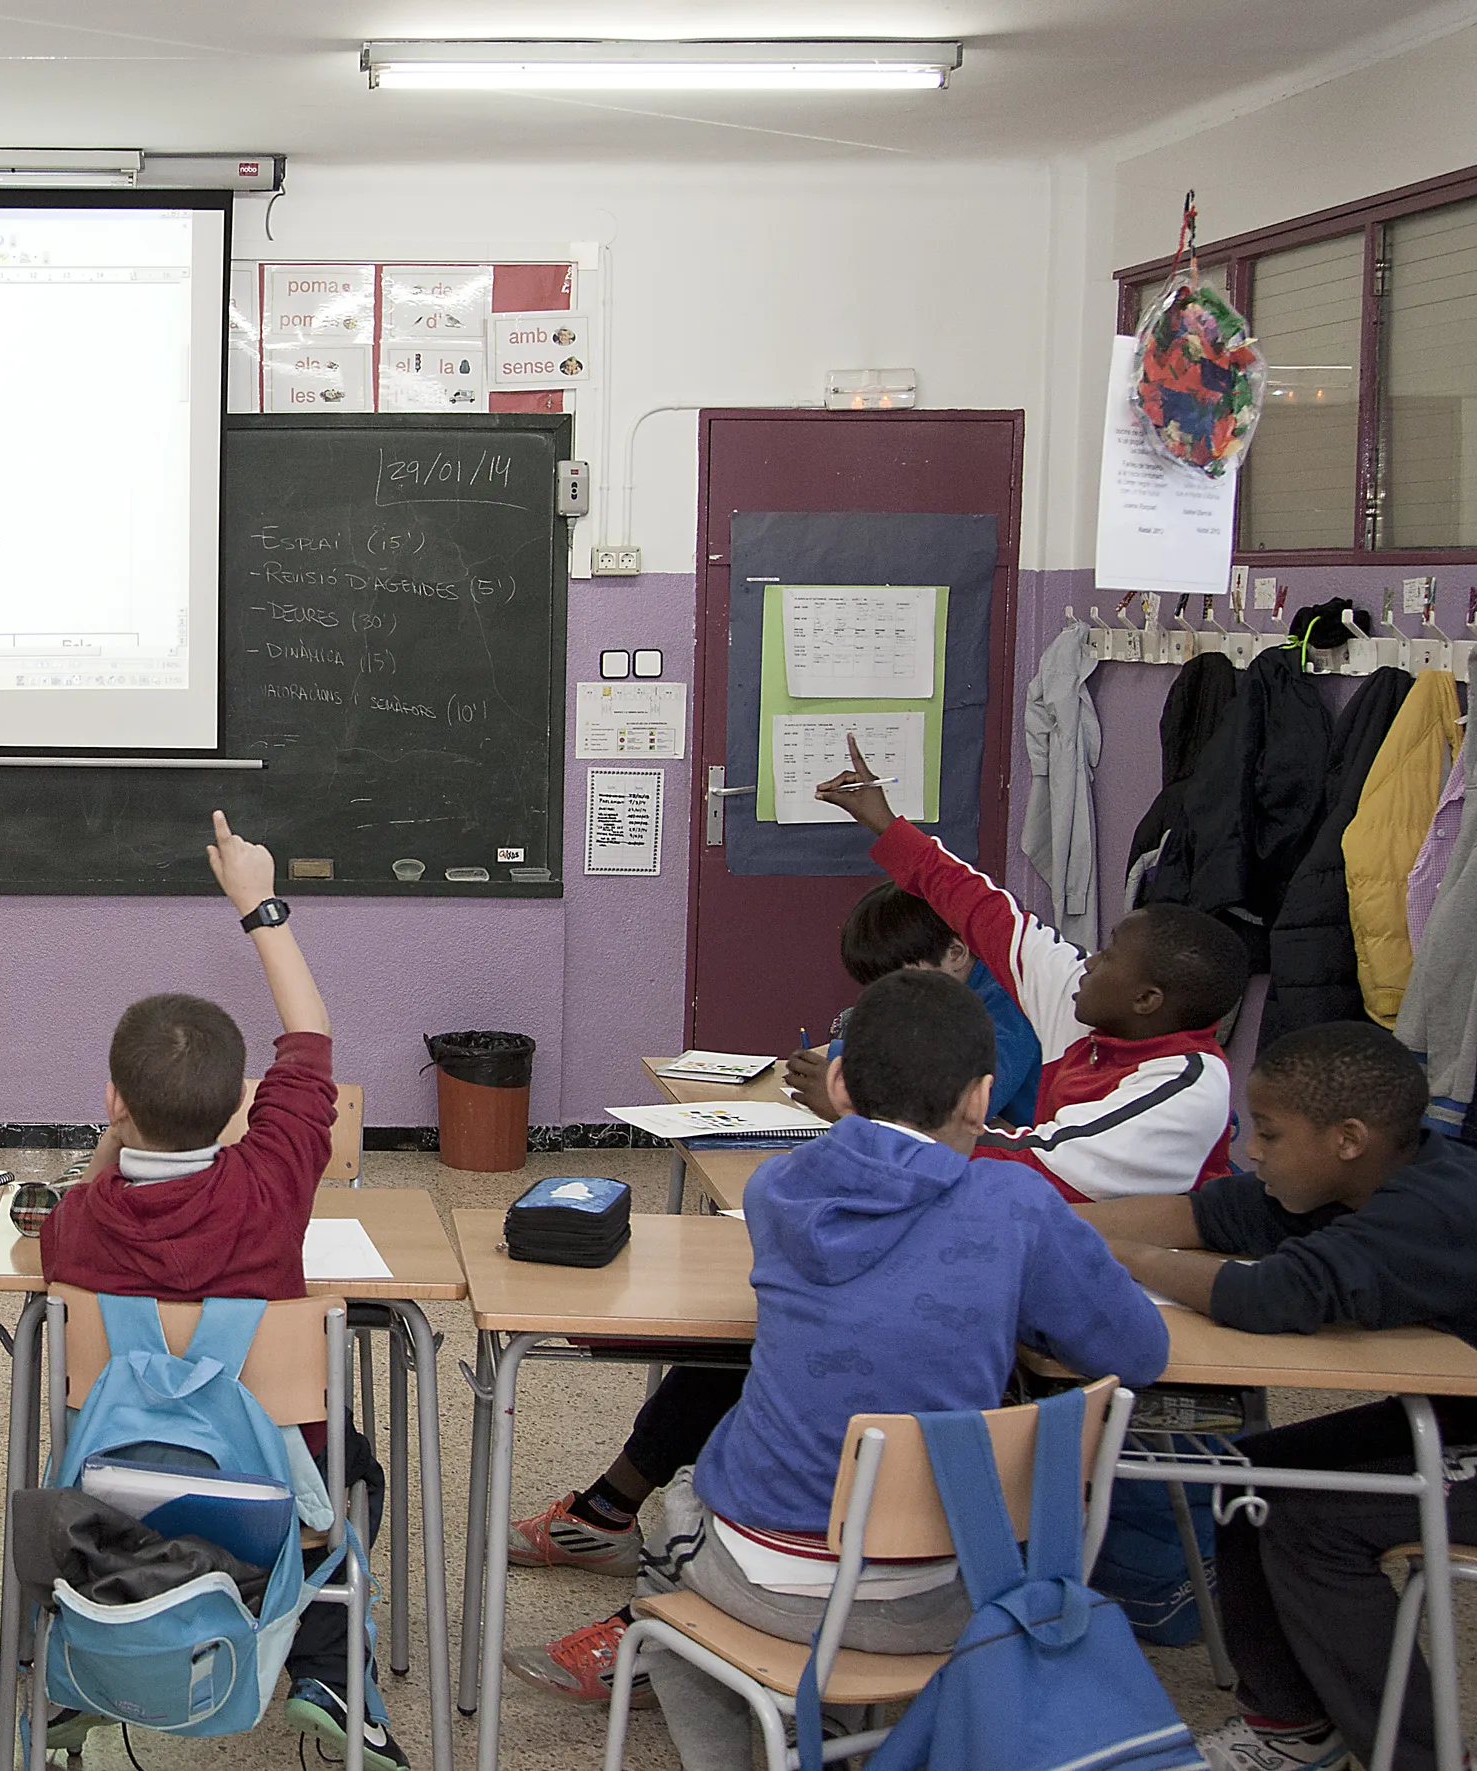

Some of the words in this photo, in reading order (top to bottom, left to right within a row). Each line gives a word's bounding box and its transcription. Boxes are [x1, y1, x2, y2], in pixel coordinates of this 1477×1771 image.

[239, 165, 257, 173] nobo
[288, 280, 338, 296] poma
[508, 327, 548, 345] amb
[395, 357, 411, 372] el
[439, 358, 455, 375] la
[502, 359, 555, 375] sense
[290, 387, 316, 404] les
[389, 450, 512, 488] 29/01/14
[270, 600, 340, 627] DEURES
